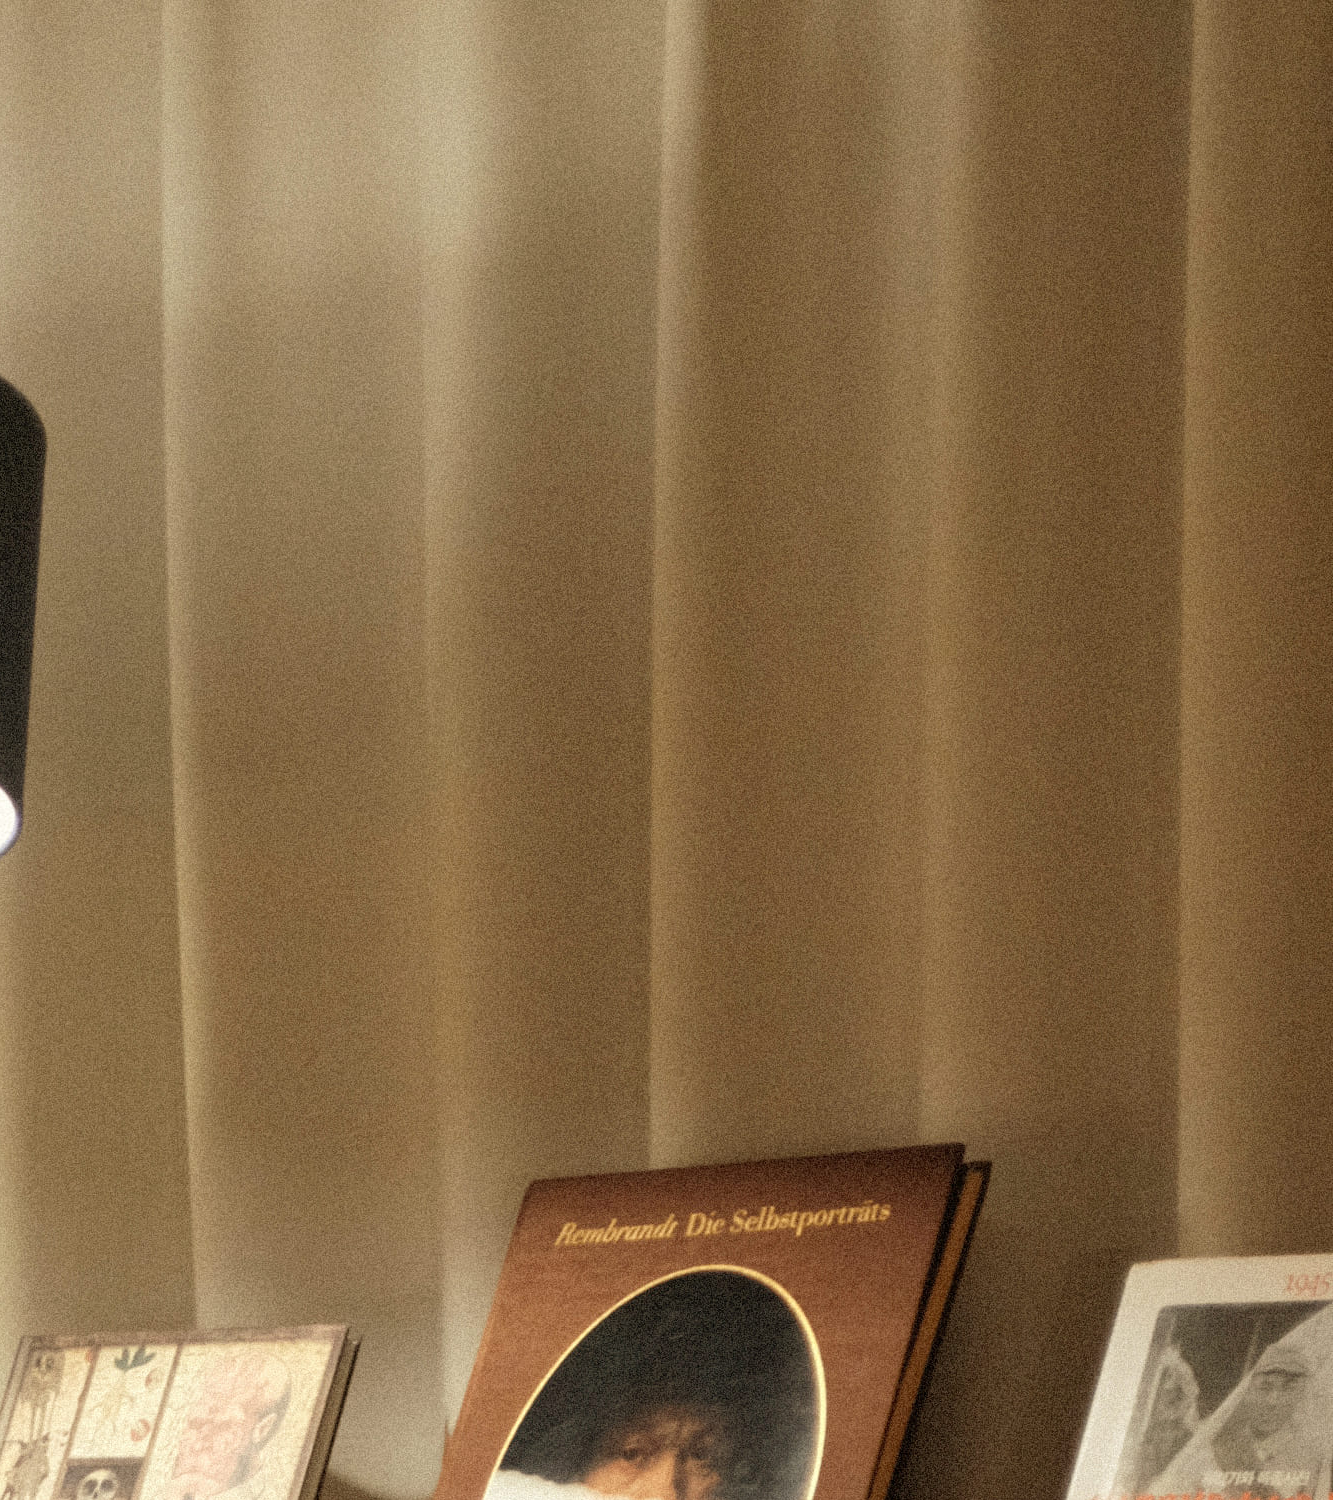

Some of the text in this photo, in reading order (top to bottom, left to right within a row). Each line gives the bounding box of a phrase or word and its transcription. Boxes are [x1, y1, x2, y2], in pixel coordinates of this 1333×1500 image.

[554, 1199, 893, 1247] Rembrandt Die Selbstporträts
